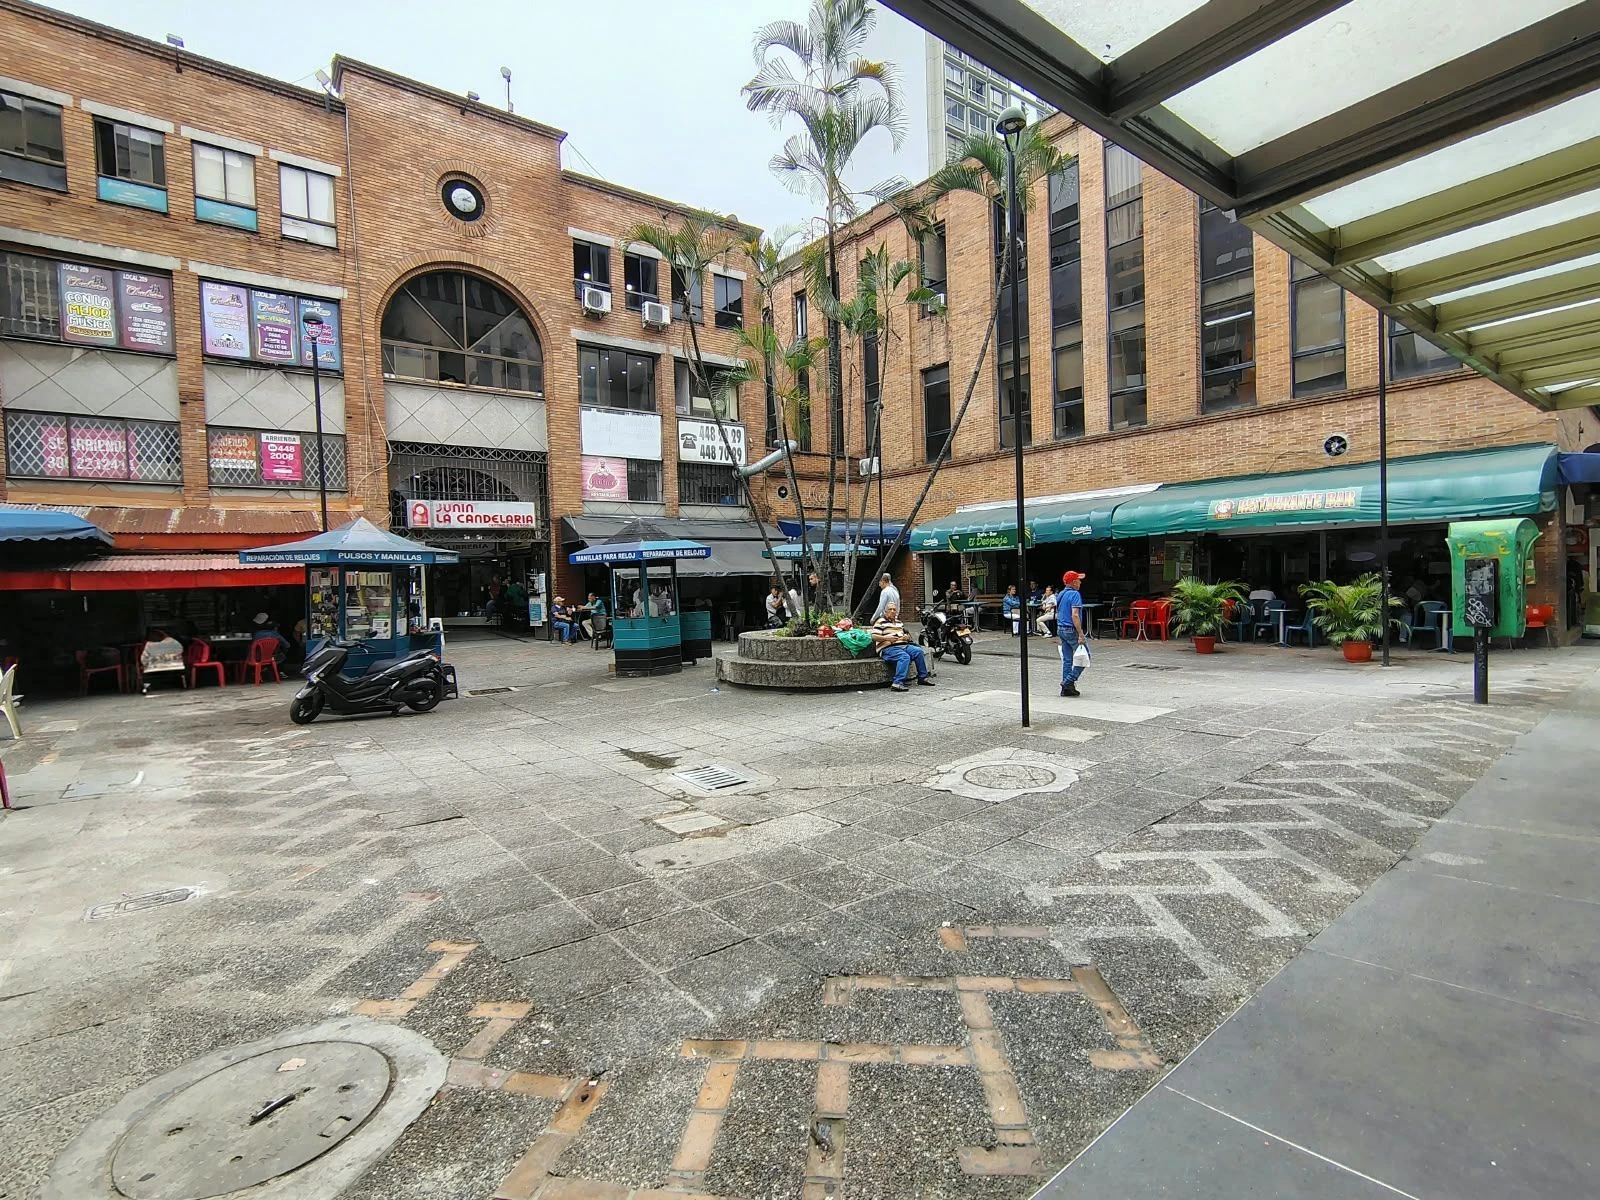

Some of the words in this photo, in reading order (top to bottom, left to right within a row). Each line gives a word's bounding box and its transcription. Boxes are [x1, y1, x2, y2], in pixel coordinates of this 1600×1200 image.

[62, 264, 79, 272] LOCAL
[123, 273, 139, 282] LOCAL
[66, 292, 91, 304] CON
[92, 295, 111, 309] LA
[67, 304, 110, 318] MEJOR
[265, 435, 296, 443] ARRIENDA
[699, 425, 716, 441] 448
[731, 429, 742, 443] 29
[48, 436, 66, 450] SE
[700, 445, 716, 460] 448
[719, 446, 729, 461] 70
[1324, 490, 1356, 509] BAR
[436, 503, 474, 513] JUNIN
[436, 514, 452, 524] LA
[457, 514, 534, 524] CANDELARIA
[294, 553, 321, 561] RELOJES
[338, 552, 373, 560] PULSOS
[683, 548, 706, 556] RELOJES
